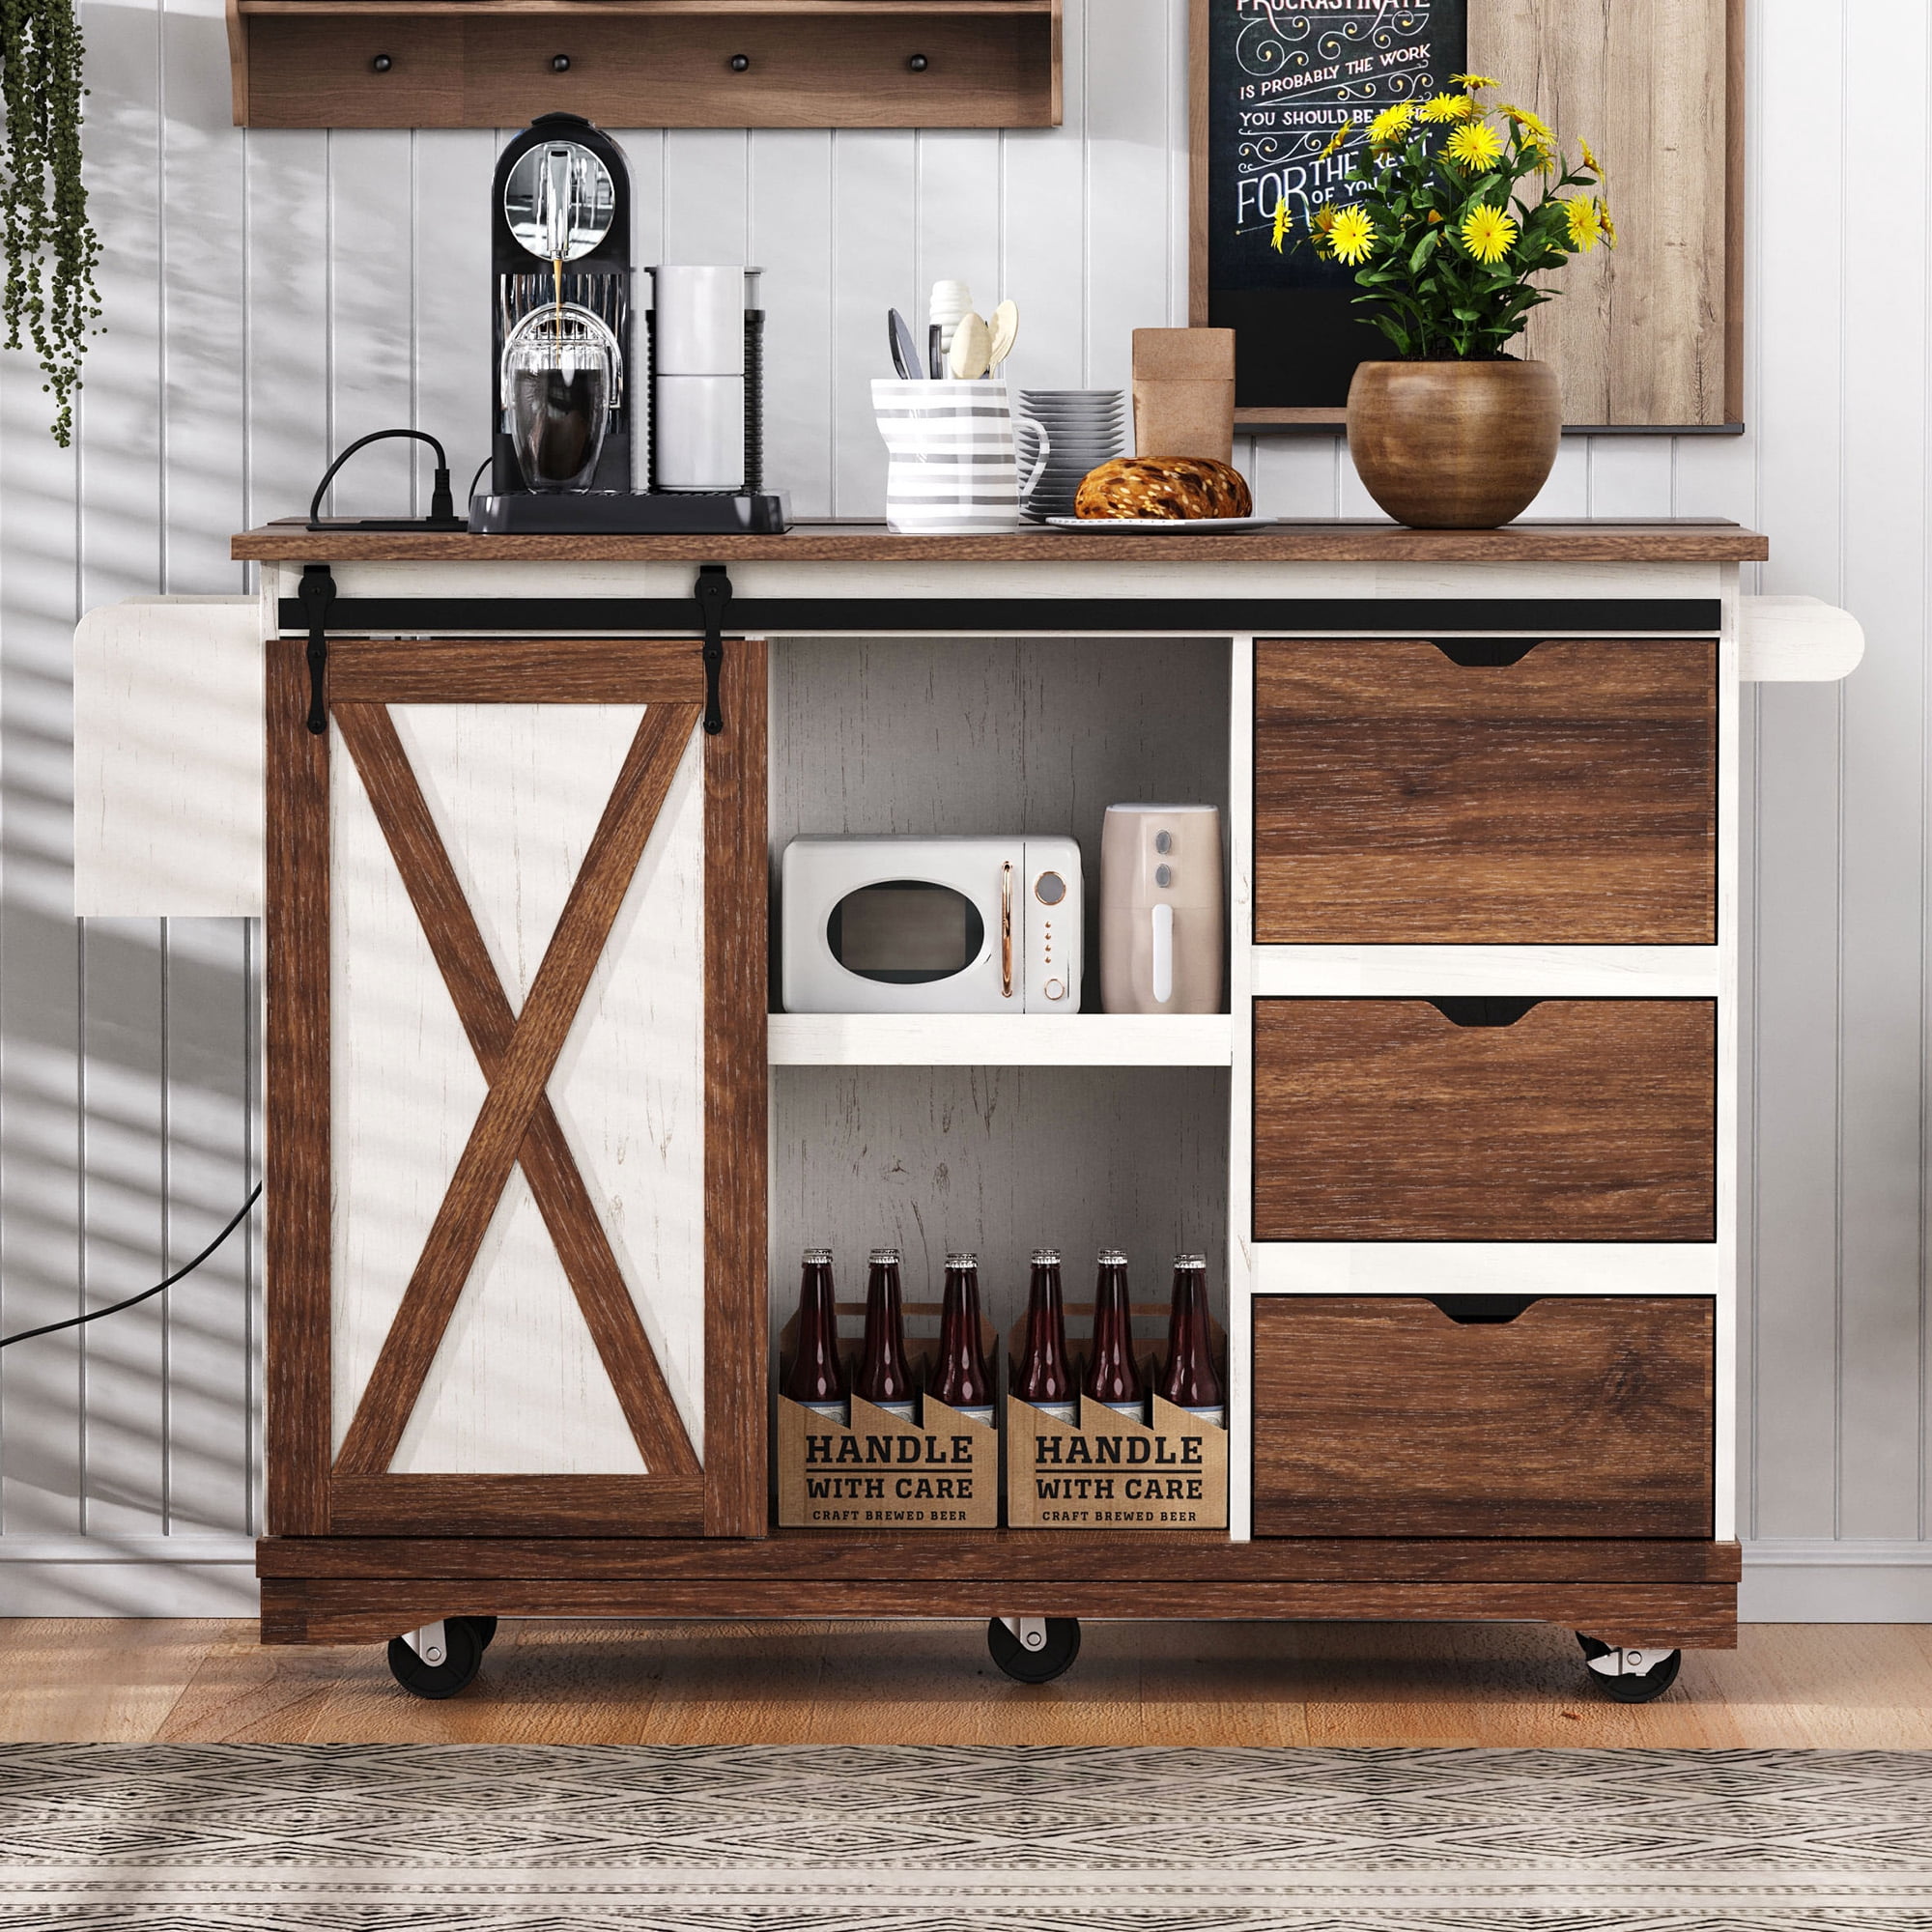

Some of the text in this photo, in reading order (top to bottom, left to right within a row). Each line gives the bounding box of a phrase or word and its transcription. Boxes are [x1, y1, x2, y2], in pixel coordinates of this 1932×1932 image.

[1239, 43, 1432, 100] IS PROBABLY THE WORK
[1239, 111, 1276, 127] YOU
[1282, 108, 1349, 126] SHOULD
[1352, 108, 1375, 124] BE
[1308, 151, 1360, 186] THE
[1236, 166, 1313, 233] FOR
[1311, 186, 1336, 205] OF
[806, 1435, 973, 1463] HANDLE
[1036, 1436, 1203, 1464] HANDLE
[807, 1478, 973, 1498] WITH CARE
[1036, 1479, 1203, 1499] WITH CARE
[812, 1511, 967, 1520] CRAFT BREWED BEER
[1042, 1511, 1197, 1521] CRAFT BREWED BEER
